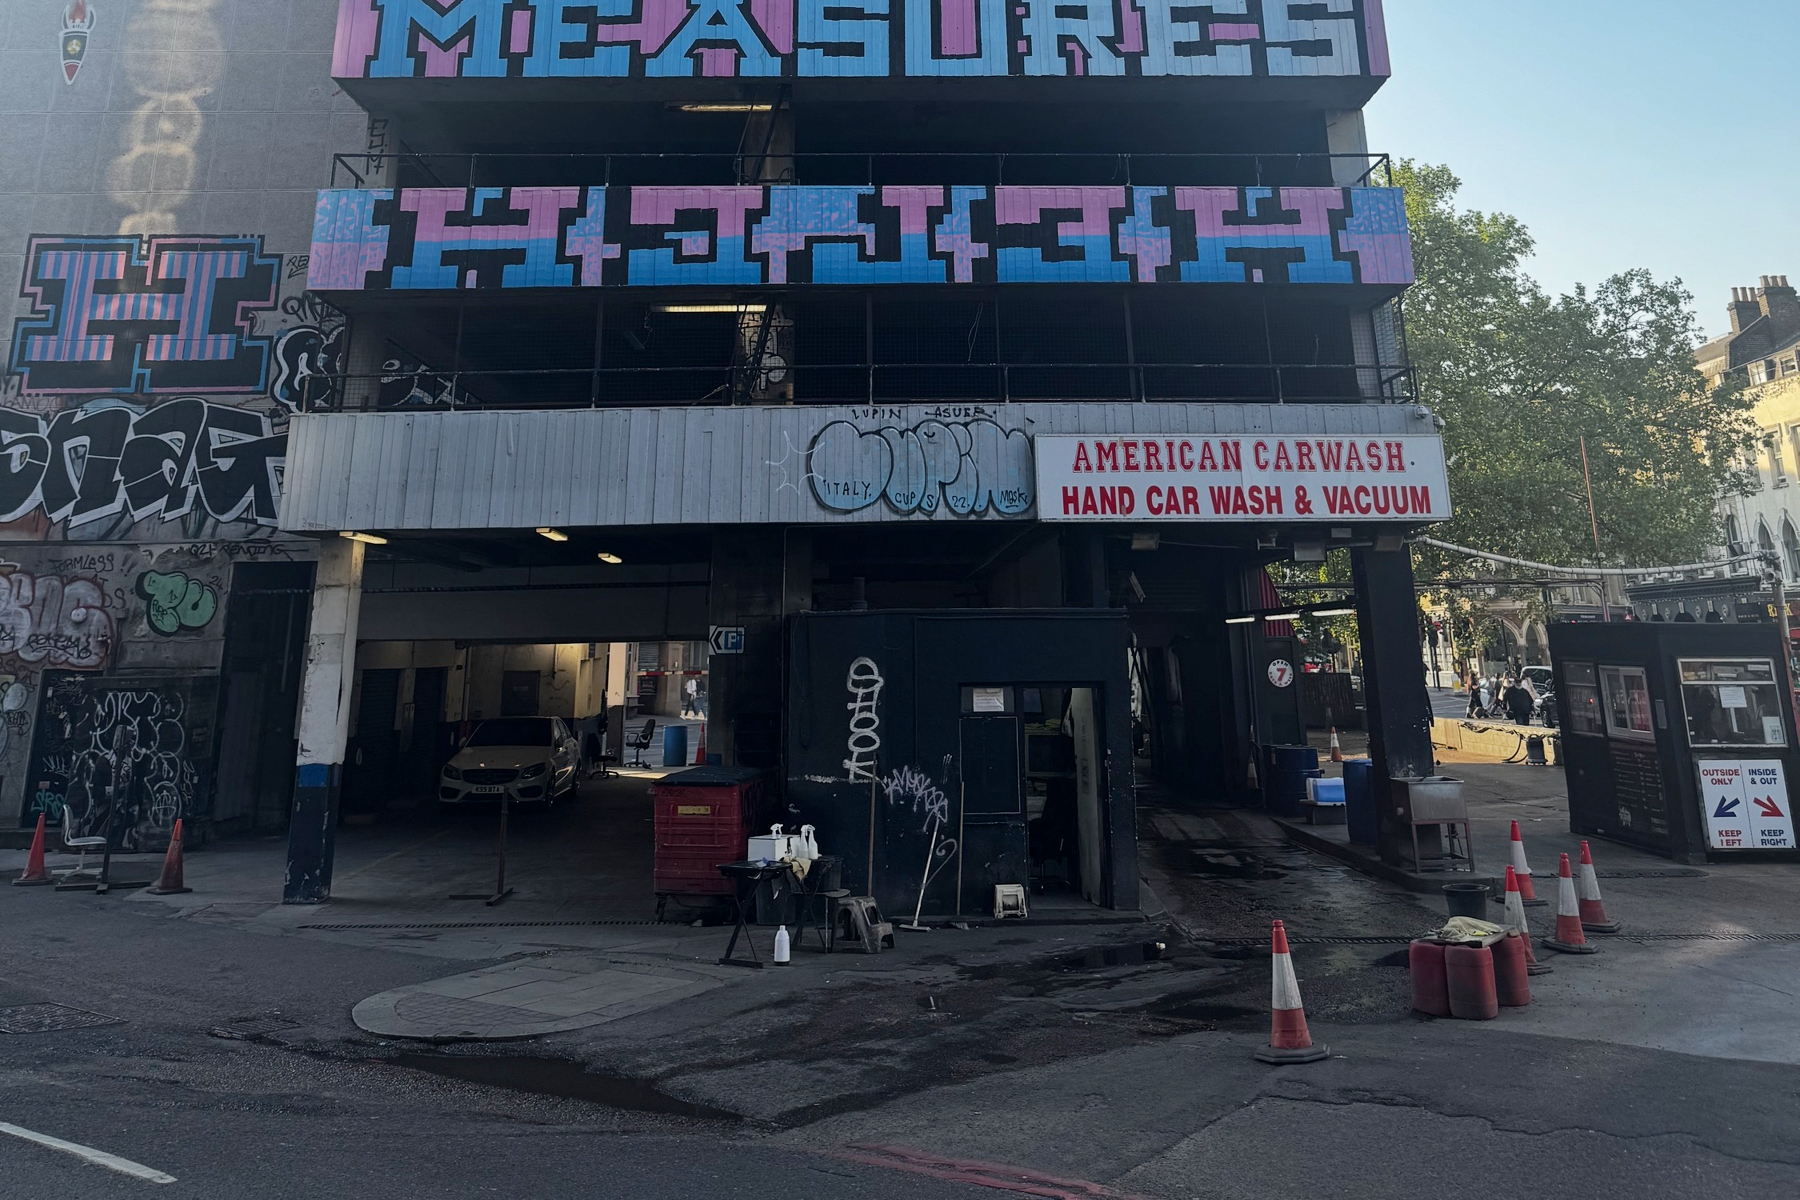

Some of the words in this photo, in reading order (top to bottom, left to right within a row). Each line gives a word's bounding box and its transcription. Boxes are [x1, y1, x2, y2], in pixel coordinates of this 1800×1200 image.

[1072, 438, 1243, 473] AMERICAN
[1254, 438, 1407, 473] CARWASH
[1061, 485, 1143, 516] HAND
[1148, 485, 1202, 516] CAR
[1209, 485, 1291, 516] WASH
[1295, 484, 1314, 516] &
[1322, 484, 1432, 516] VACUUM
[1276, 668, 1287, 682] 7
[1702, 768, 1740, 777] OUTSIDE
[1748, 768, 1777, 776] INSIDE
[1710, 778, 1734, 786] ONLY
[1760, 777, 1778, 785] OUT
[1718, 829, 1742, 838] KEEP
[1760, 829, 1785, 837] KEEP
[1760, 838, 1787, 847] RIGHT
